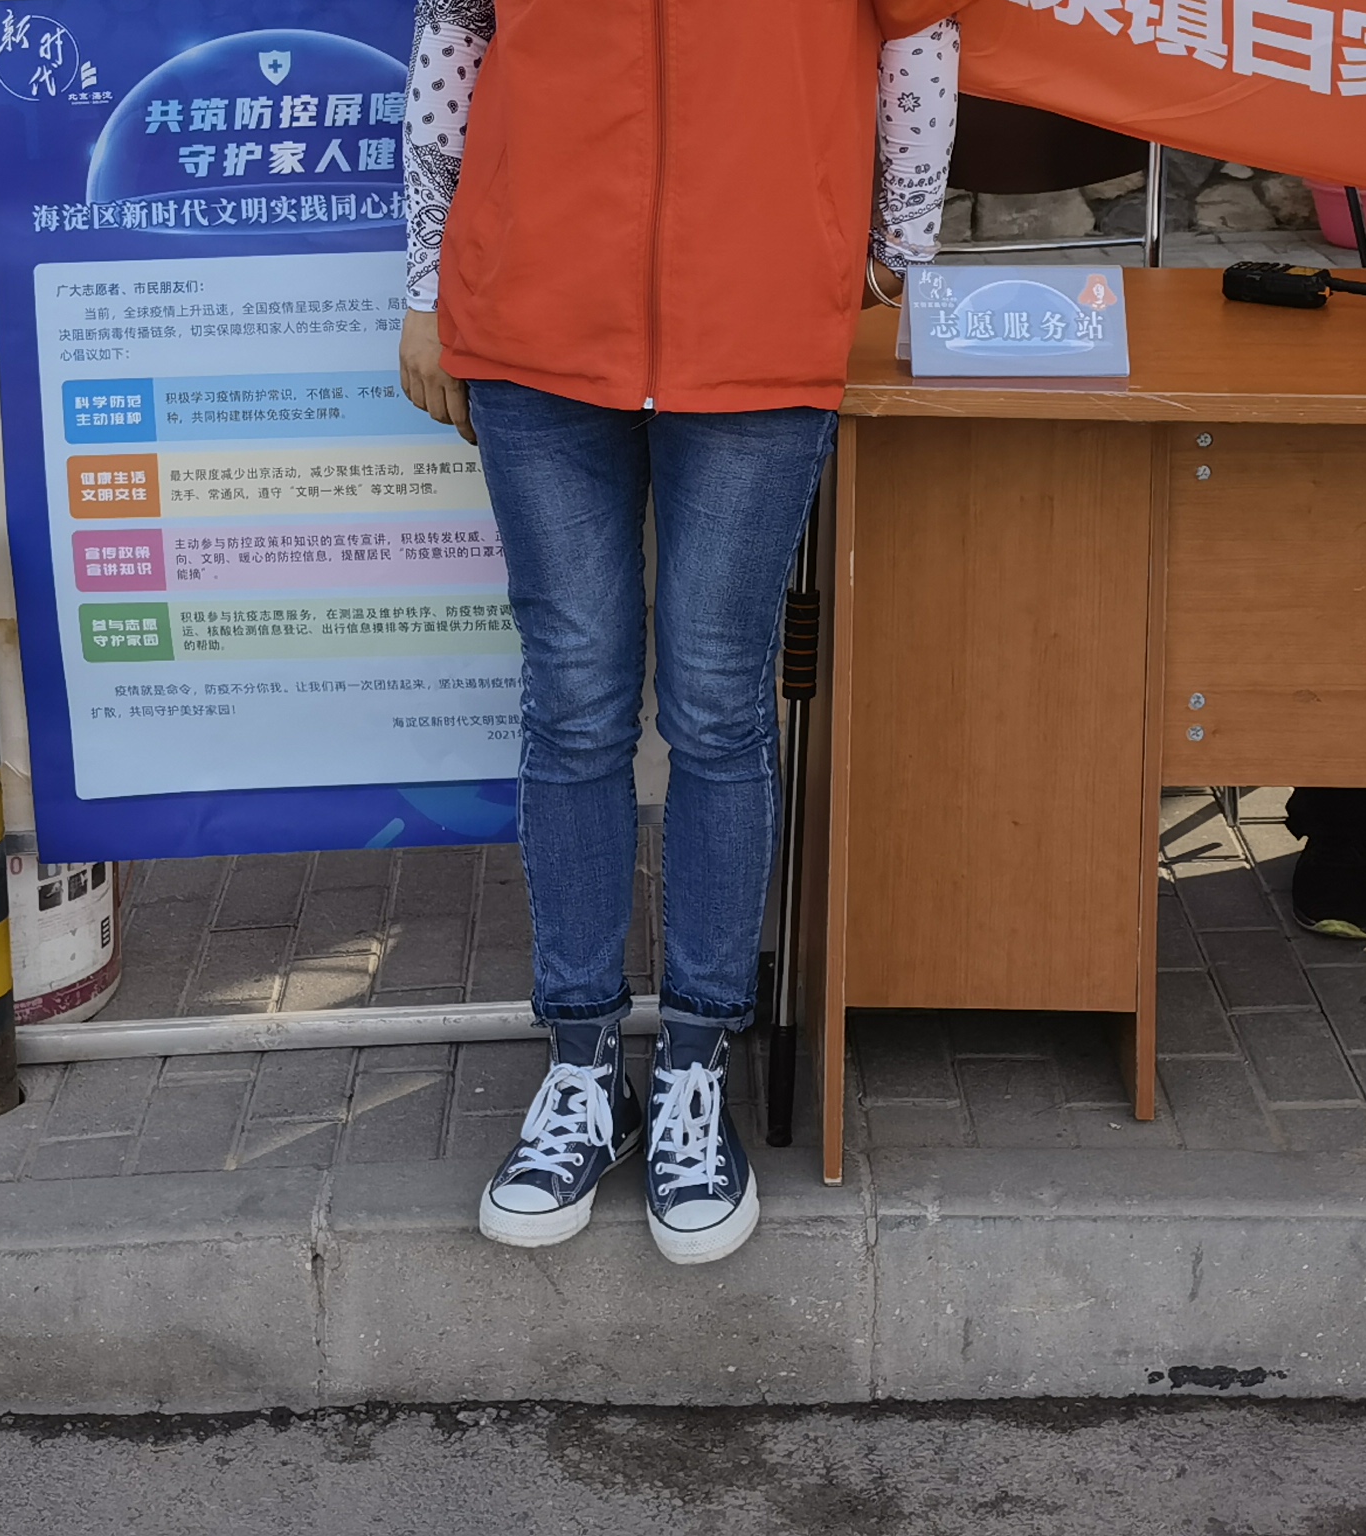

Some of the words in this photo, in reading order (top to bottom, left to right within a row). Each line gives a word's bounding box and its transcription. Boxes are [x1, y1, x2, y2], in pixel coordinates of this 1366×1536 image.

[144, 91, 406, 136] 共筑防控屏障
[178, 137, 397, 178] 守护家人健
[55, 279, 206, 298] 广大志愿者、市民朋友们：
[928, 309, 1105, 342] 志愿服务站
[59, 347, 132, 363] 心倡议如下：
[74, 394, 142, 410] 科学防范
[75, 411, 143, 427] 主动接种
[80, 470, 146, 486] 健康生活
[84, 545, 151, 561] 宣传政策
[85, 562, 153, 578] 宣讲知识
[93, 634, 160, 649] 守护家园
[90, 704, 238, 720] 扩散，共同守护美好家园！
